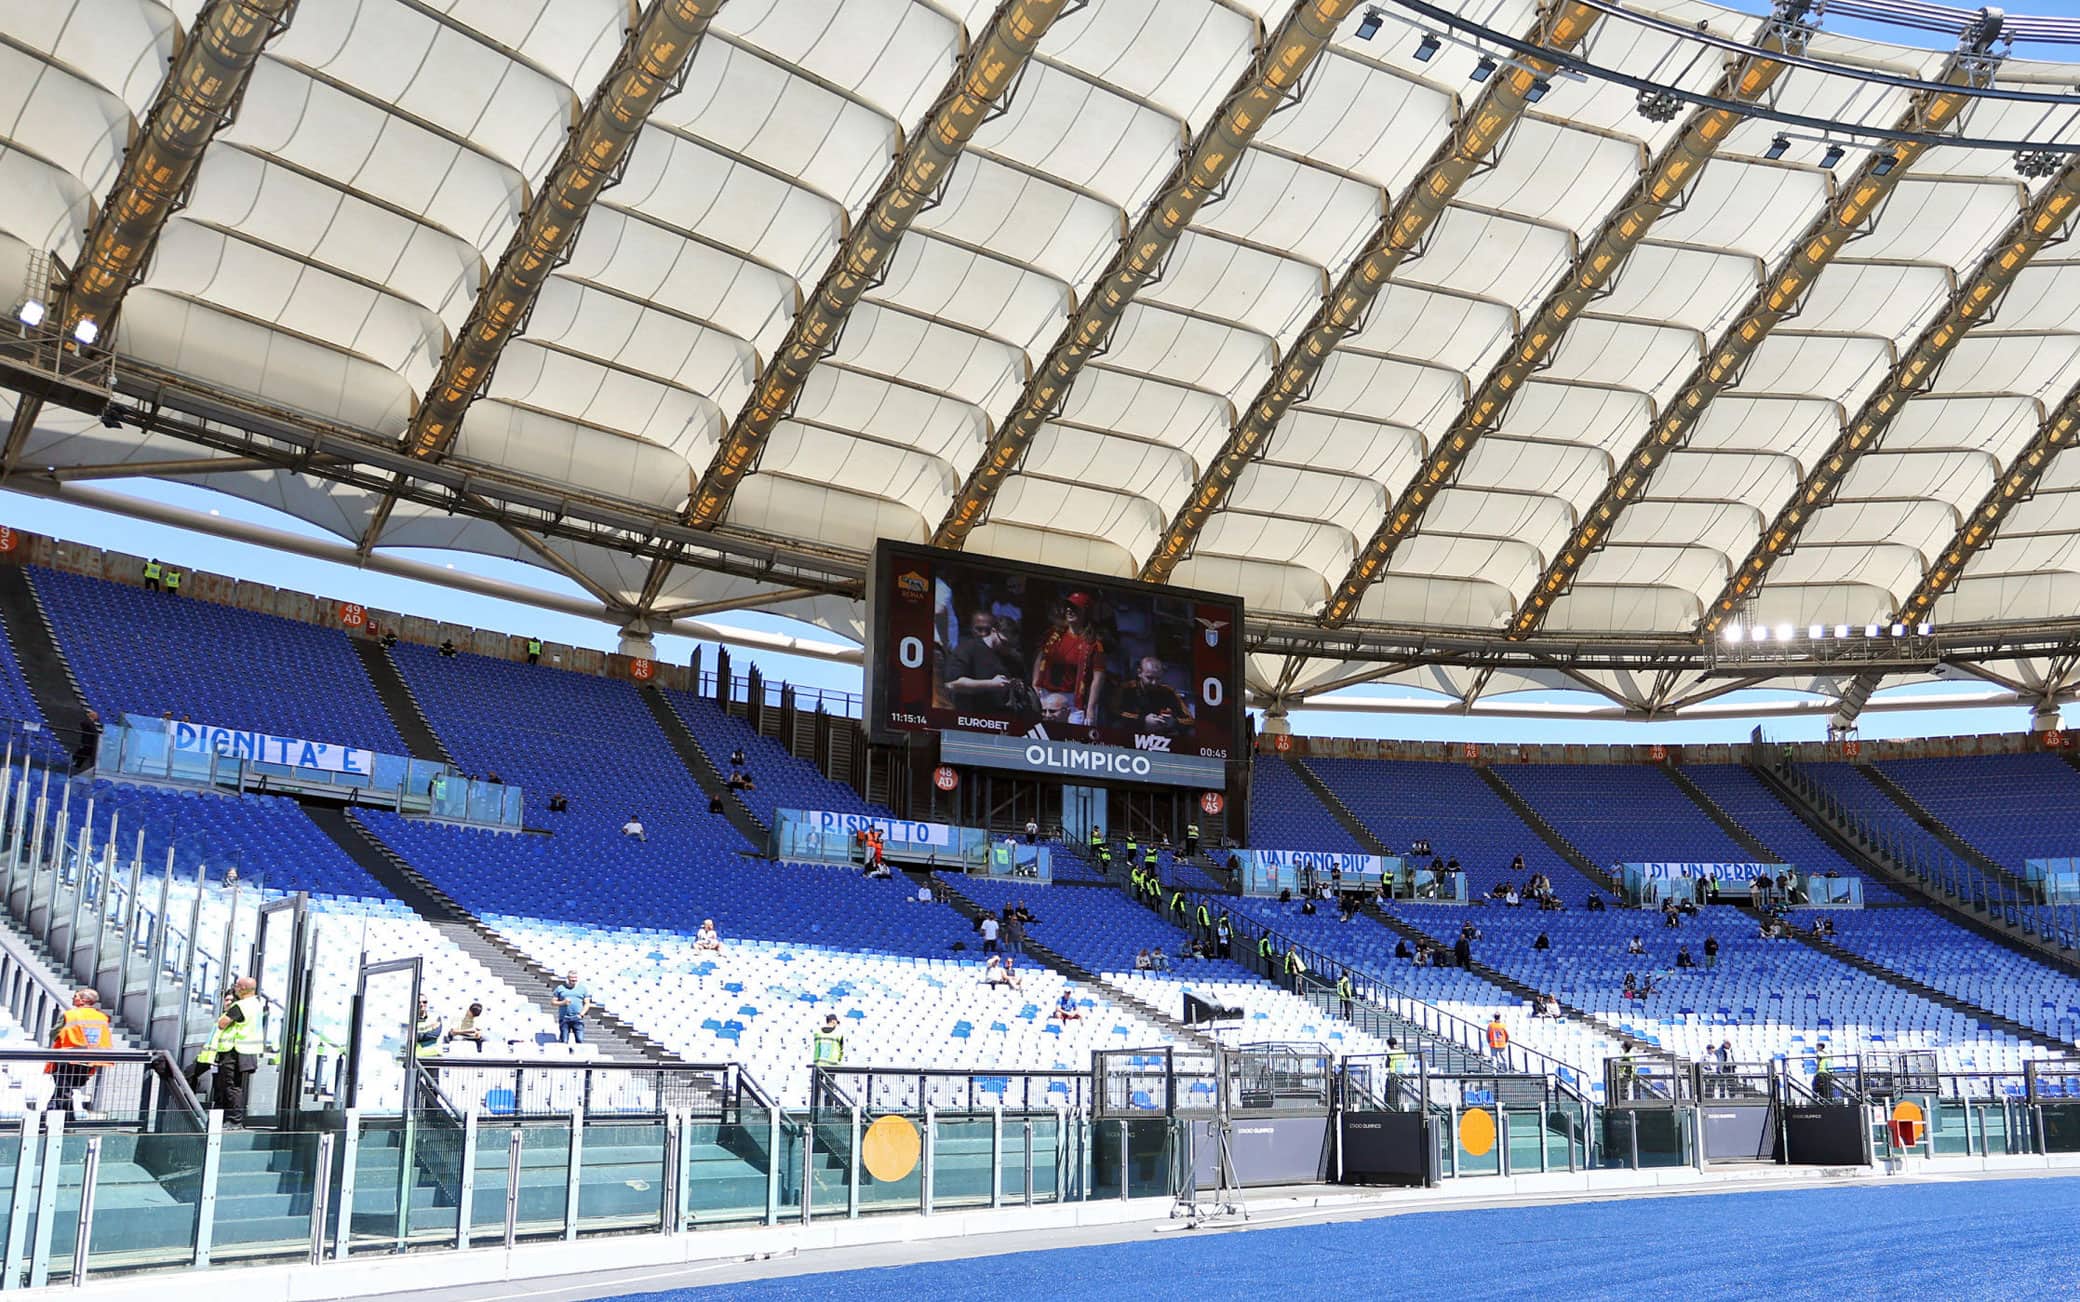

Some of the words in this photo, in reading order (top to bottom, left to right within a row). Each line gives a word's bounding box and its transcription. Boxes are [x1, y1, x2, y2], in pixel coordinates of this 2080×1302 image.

[345, 604, 361, 615] 49
[343, 614, 361, 625] AD
[899, 636, 924, 669] 0
[635, 658, 648, 669] 48
[634, 668, 648, 679] AS
[1202, 677, 1223, 706] 0
[891, 712, 927, 725] 11:15:14
[957, 716, 1009, 731] EUROBET
[1278, 735, 1289, 743] 47
[2046, 737, 2060, 745] AD
[175, 722, 327, 768] DIGNITA'
[343, 747, 362, 772] E
[1277, 742, 1289, 750] AD
[1200, 747, 1227, 759] 00:45
[1466, 750, 1477, 758] AS
[1652, 752, 1664, 760] AD
[1025, 745, 1151, 775] OLIMPICO
[939, 767, 953, 777] 48
[938, 777, 954, 787] AD
[1205, 792, 1219, 802] 47
[1205, 802, 1219, 812] AS
[1651, 864, 1669, 881] DI
[1680, 863, 1704, 881] UN
[1713, 864, 1763, 881] DERBY
